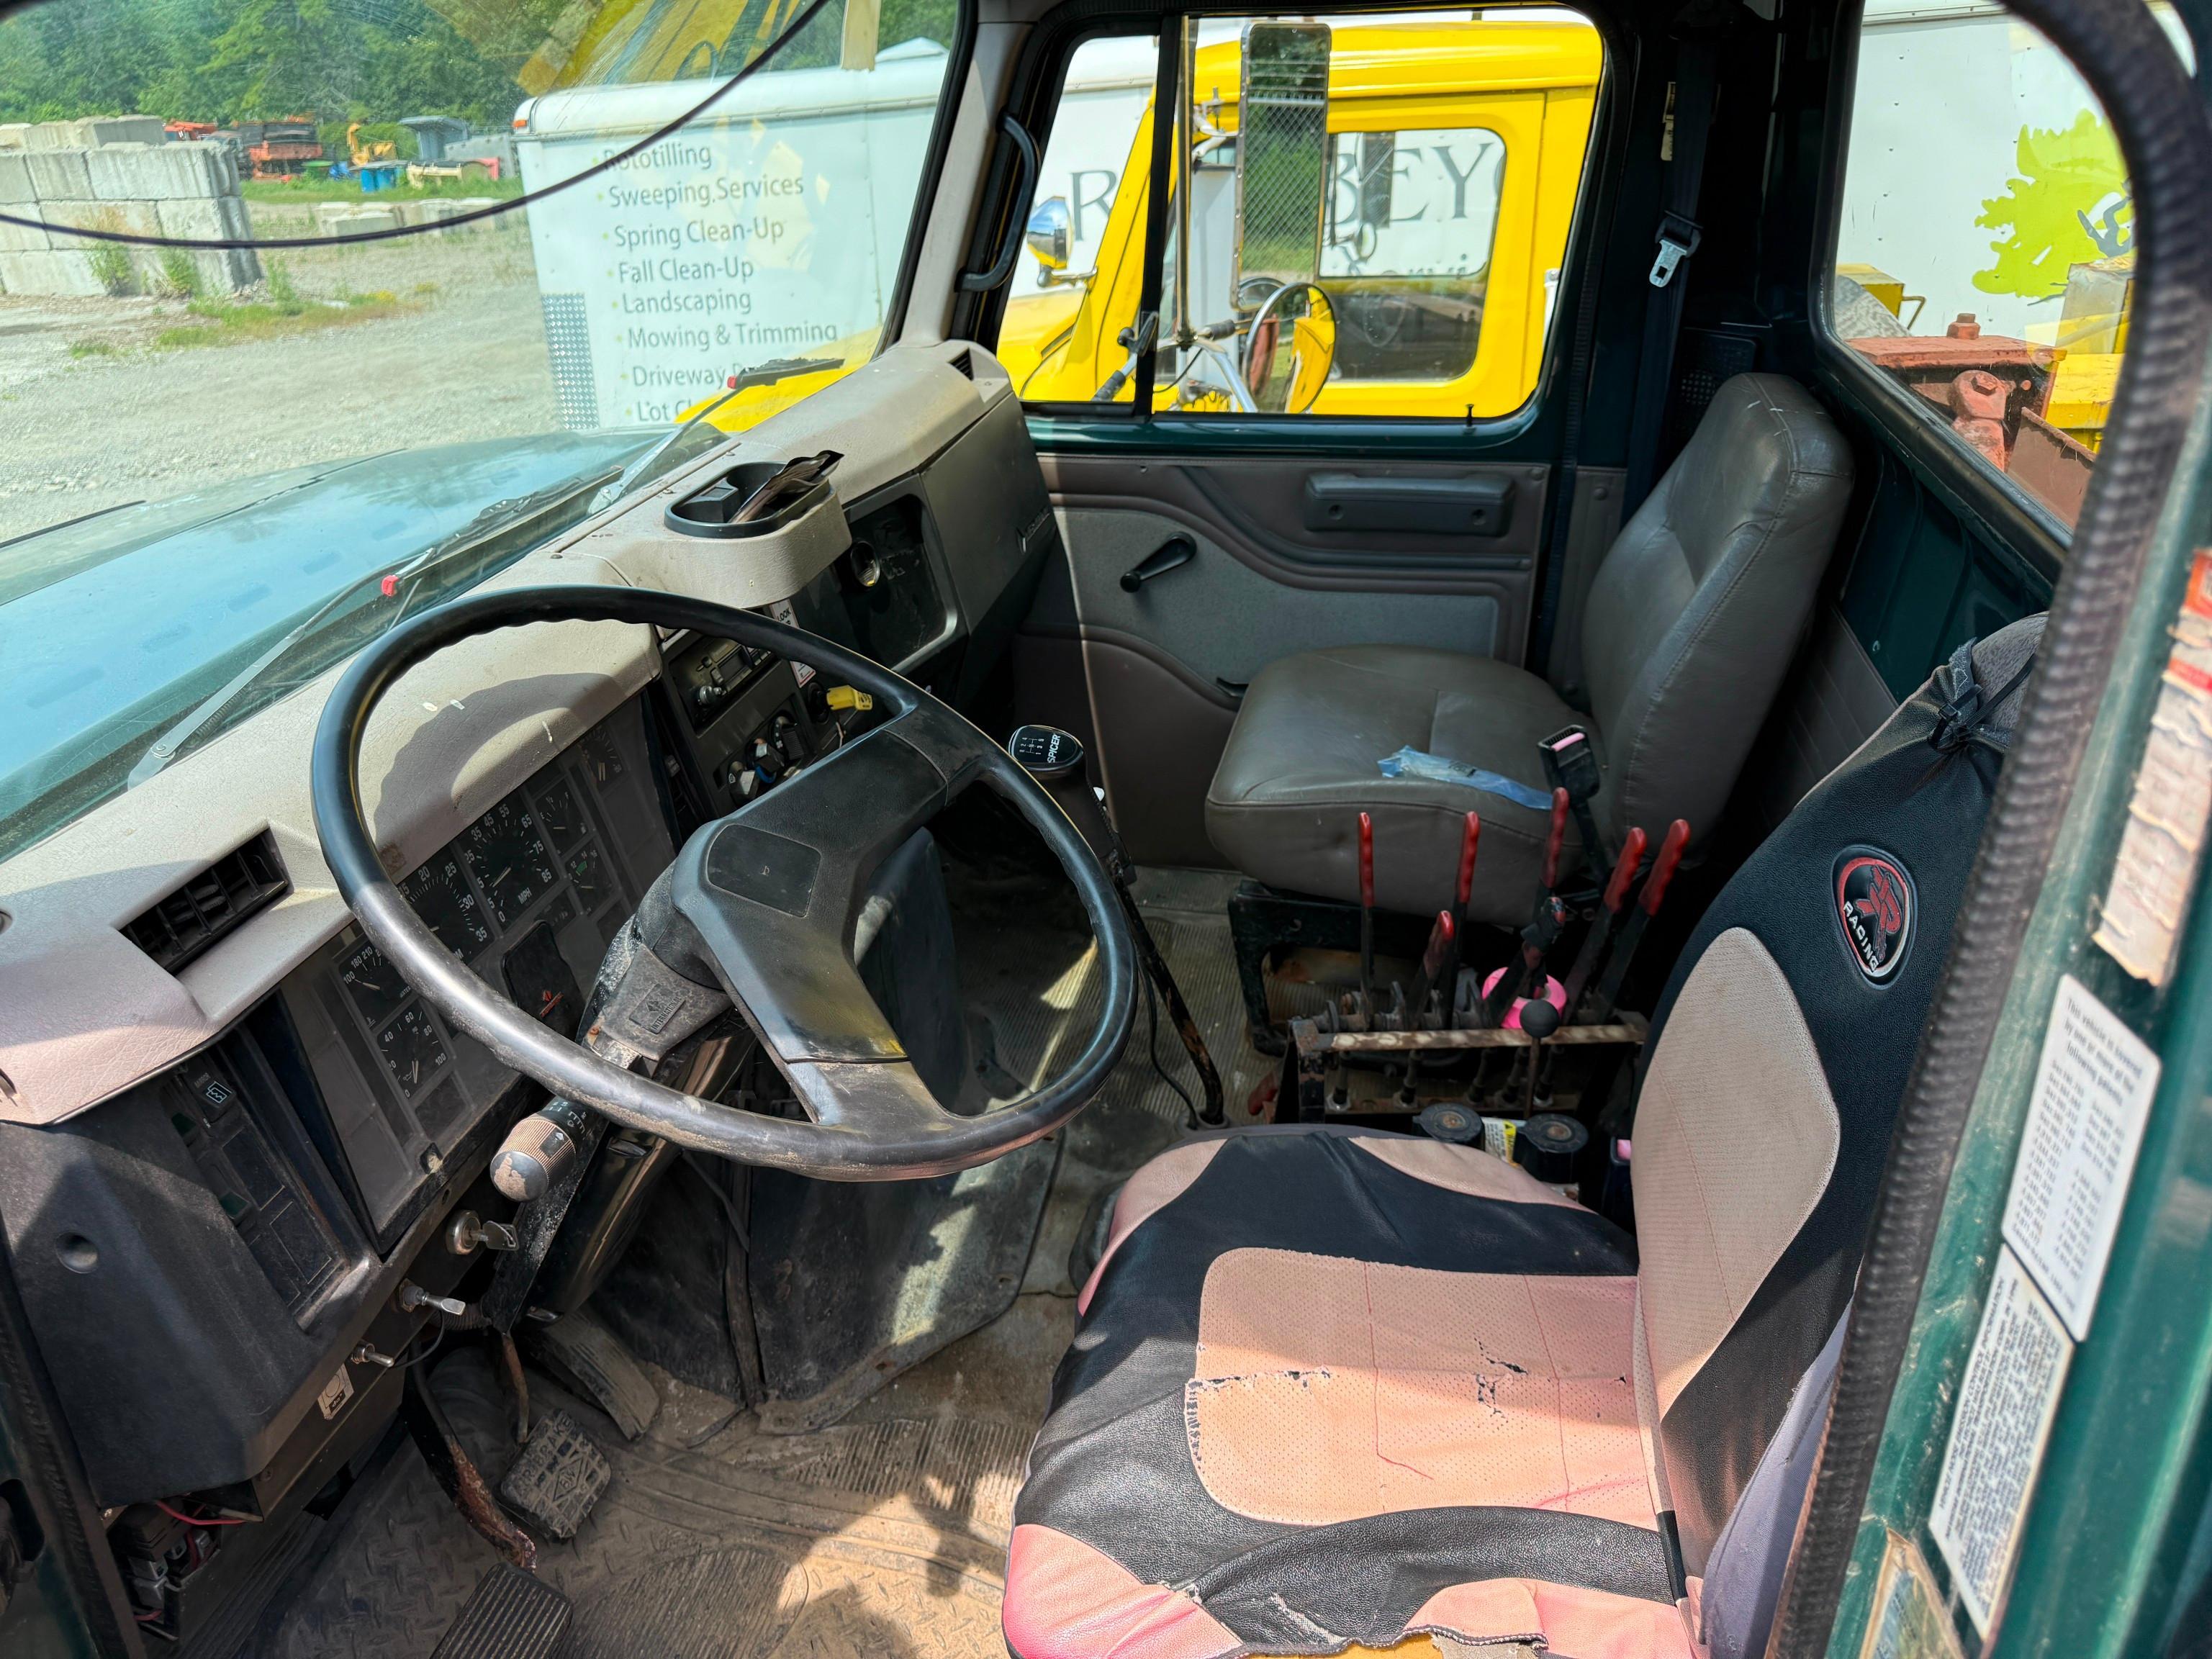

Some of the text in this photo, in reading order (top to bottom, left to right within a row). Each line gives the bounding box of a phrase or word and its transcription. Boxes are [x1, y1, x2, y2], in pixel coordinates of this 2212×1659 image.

[609, 174, 804, 209] Sweeping Services
[614, 216, 785, 251] Spring Clean-Up
[618, 256, 754, 284] Fall Clean-Up
[622, 289, 752, 315] Landscaping
[628, 320, 838, 351] Mowing & Trimming
[632, 364, 726, 390] Driveway
[637, 400, 669, 422] Lot
[777, 607, 791, 622] LOOK
[1047, 733, 1061, 763] SPICER
[499, 803, 510, 818] 55
[484, 813, 495, 827] 45
[521, 814, 533, 828] 65
[471, 826, 482, 841] 35
[533, 841, 544, 854] 75
[418, 865, 430, 882] 20
[445, 862, 456, 877] 25
[541, 868, 552, 883] 85
[463, 894, 474, 909] 30
[518, 887, 533, 904] MPH
[498, 910, 505, 922] 0
[476, 926, 487, 941] 35
[1843, 900, 1879, 973] RACING
[361, 946, 373, 960] 210
[351, 955, 362, 968] 180
[343, 971, 355, 984] 100
[405, 1012, 415, 1023] 60
[650, 996, 682, 1031] INTERNATIONAL
[384, 1031, 394, 1042] 40
[423, 1025, 432, 1036] 80
[435, 1052, 446, 1065] 100
[405, 1089, 410, 1098] 0
